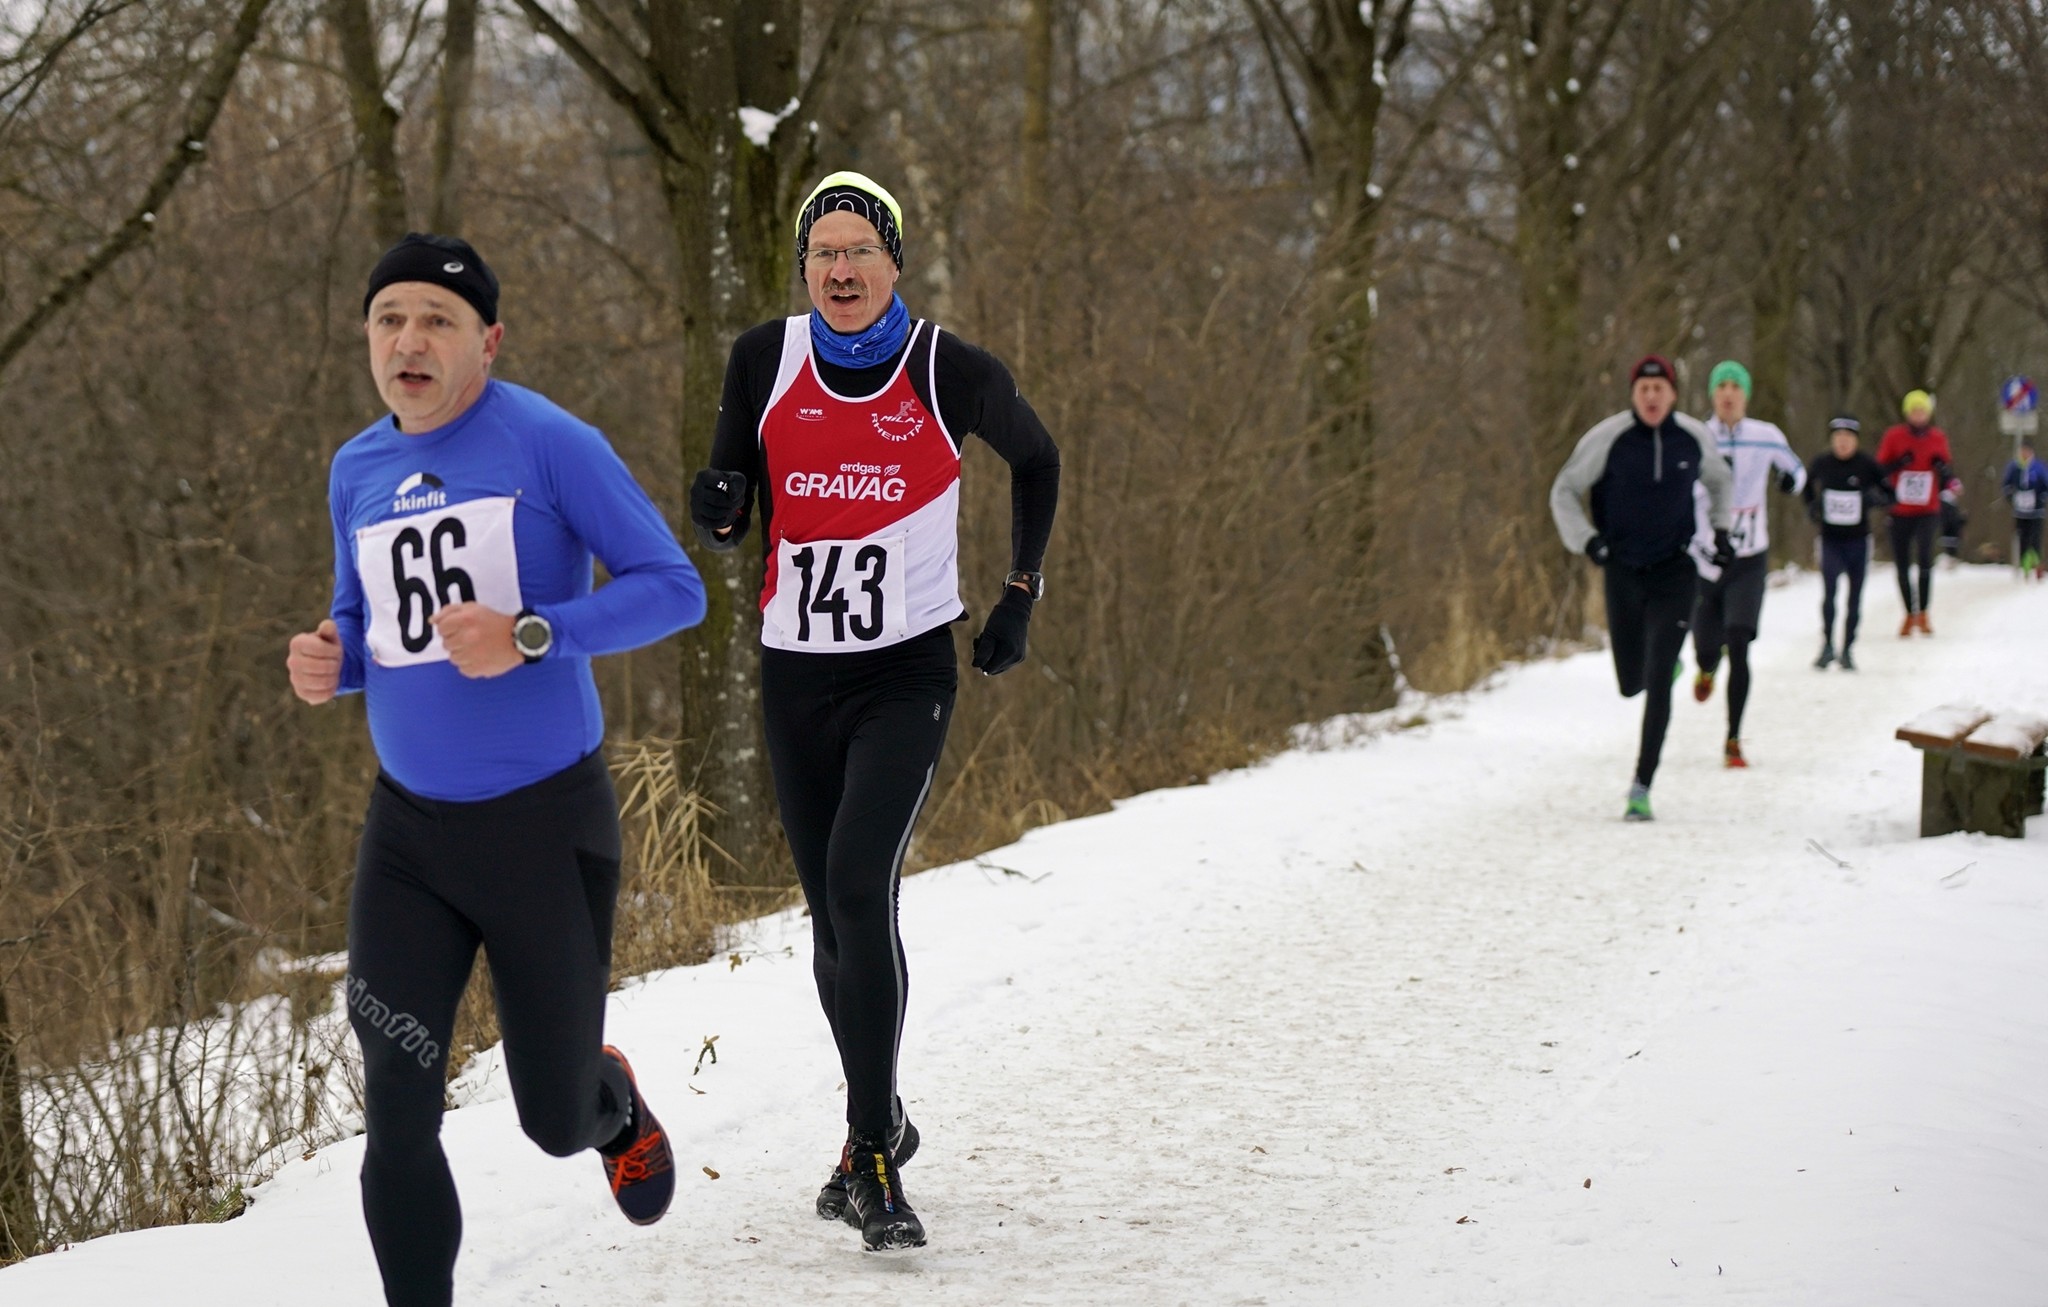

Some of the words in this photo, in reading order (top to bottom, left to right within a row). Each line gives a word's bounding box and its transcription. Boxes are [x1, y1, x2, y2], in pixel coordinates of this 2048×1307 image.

[871, 412, 925, 442] RHEINTAL
[840, 462, 881, 475] erdgas
[785, 472, 906, 501] GRAVAG
[393, 490, 447, 513] skinfit
[391, 517, 477, 653] 66
[791, 544, 888, 642] 143
